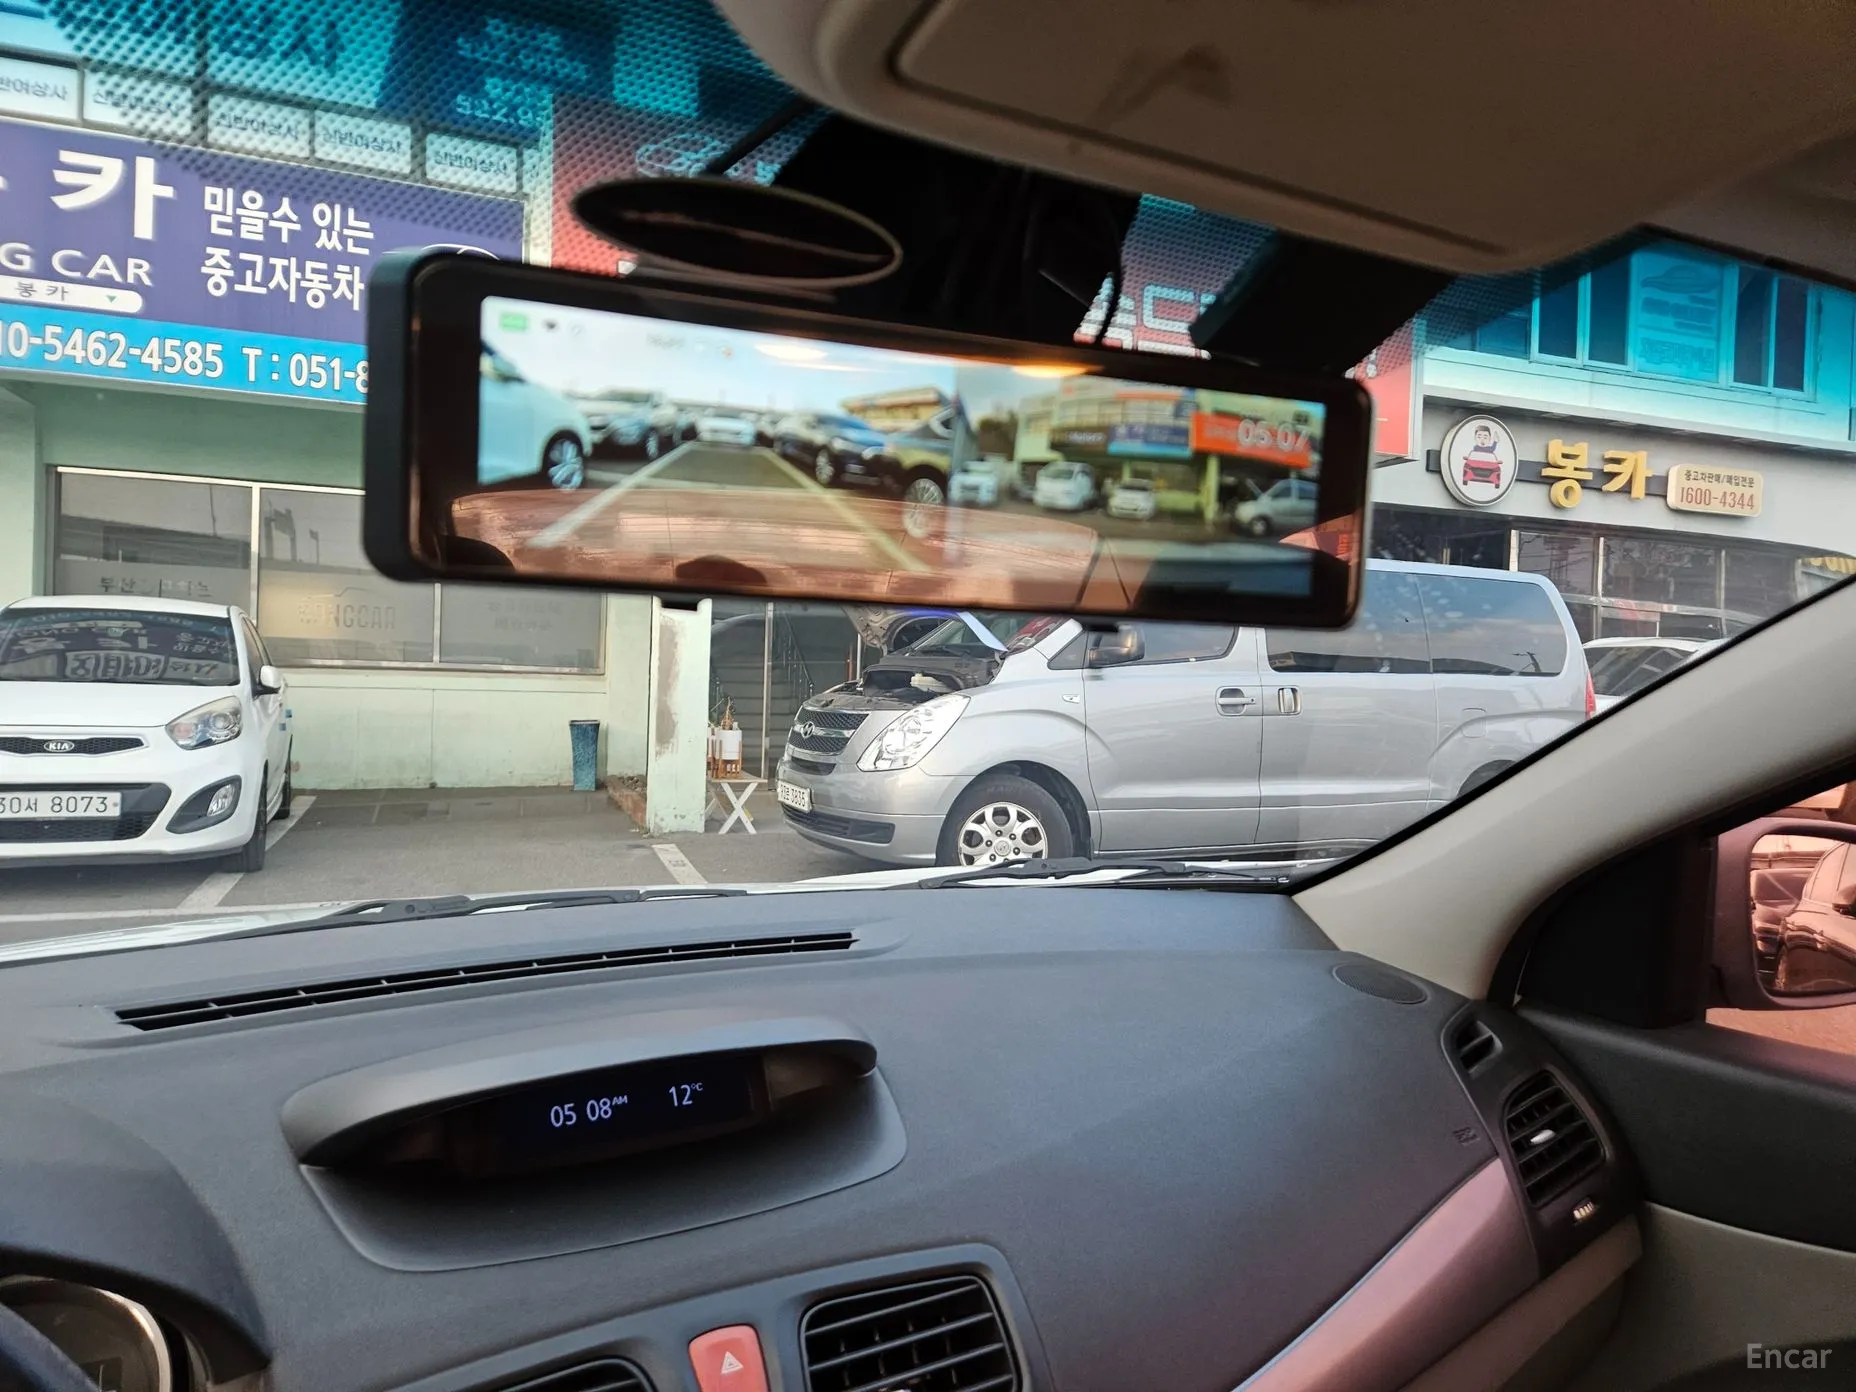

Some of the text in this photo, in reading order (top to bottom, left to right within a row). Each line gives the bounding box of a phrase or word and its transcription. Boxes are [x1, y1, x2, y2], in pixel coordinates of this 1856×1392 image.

[204, 185, 375, 255] 믿을수 있는
[51, 249, 153, 286] CAR
[200, 246, 366, 311] 중고자동차
[1680, 486, 1755, 510] 1600-4344
[48, 742, 70, 751] KIA
[50, 796, 108, 814] 8073
